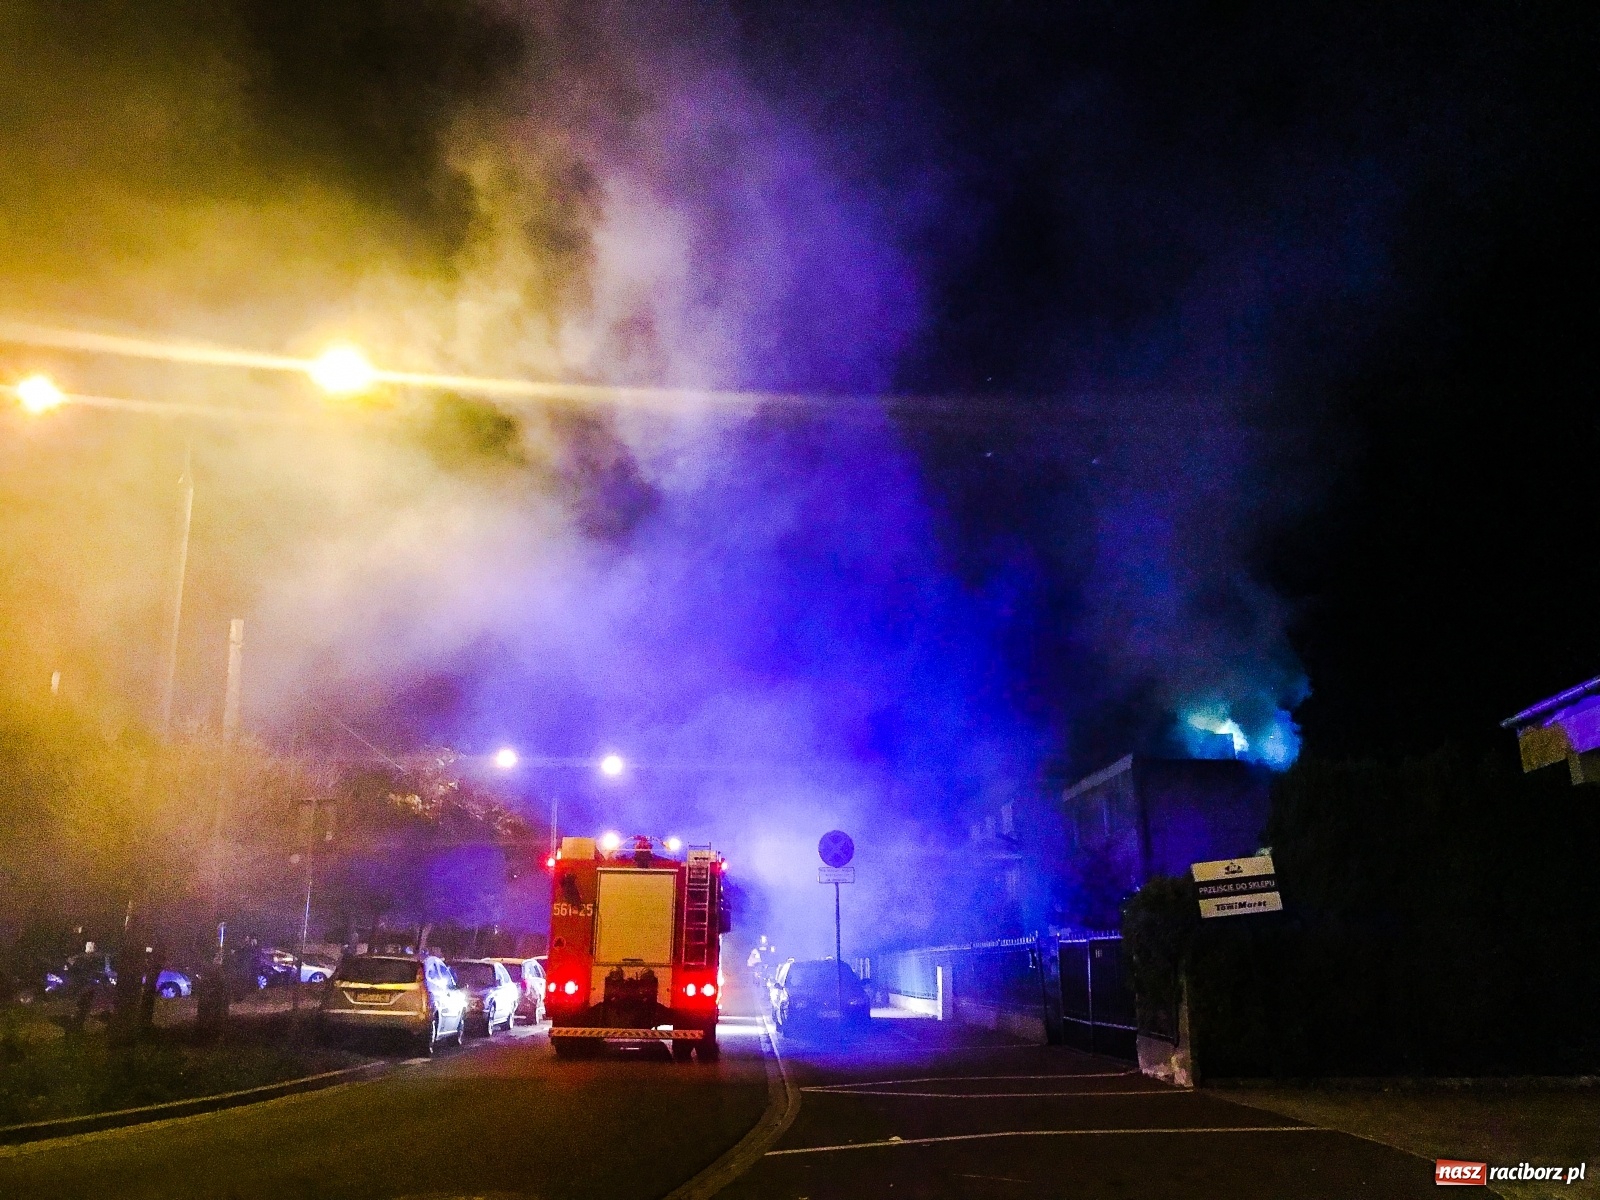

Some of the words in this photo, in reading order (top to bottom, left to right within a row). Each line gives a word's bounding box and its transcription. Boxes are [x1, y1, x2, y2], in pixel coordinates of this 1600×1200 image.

[1236, 882, 1247, 890] DO
[1248, 880, 1275, 889] SKLEPU
[553, 903, 594, 917] 561-25
